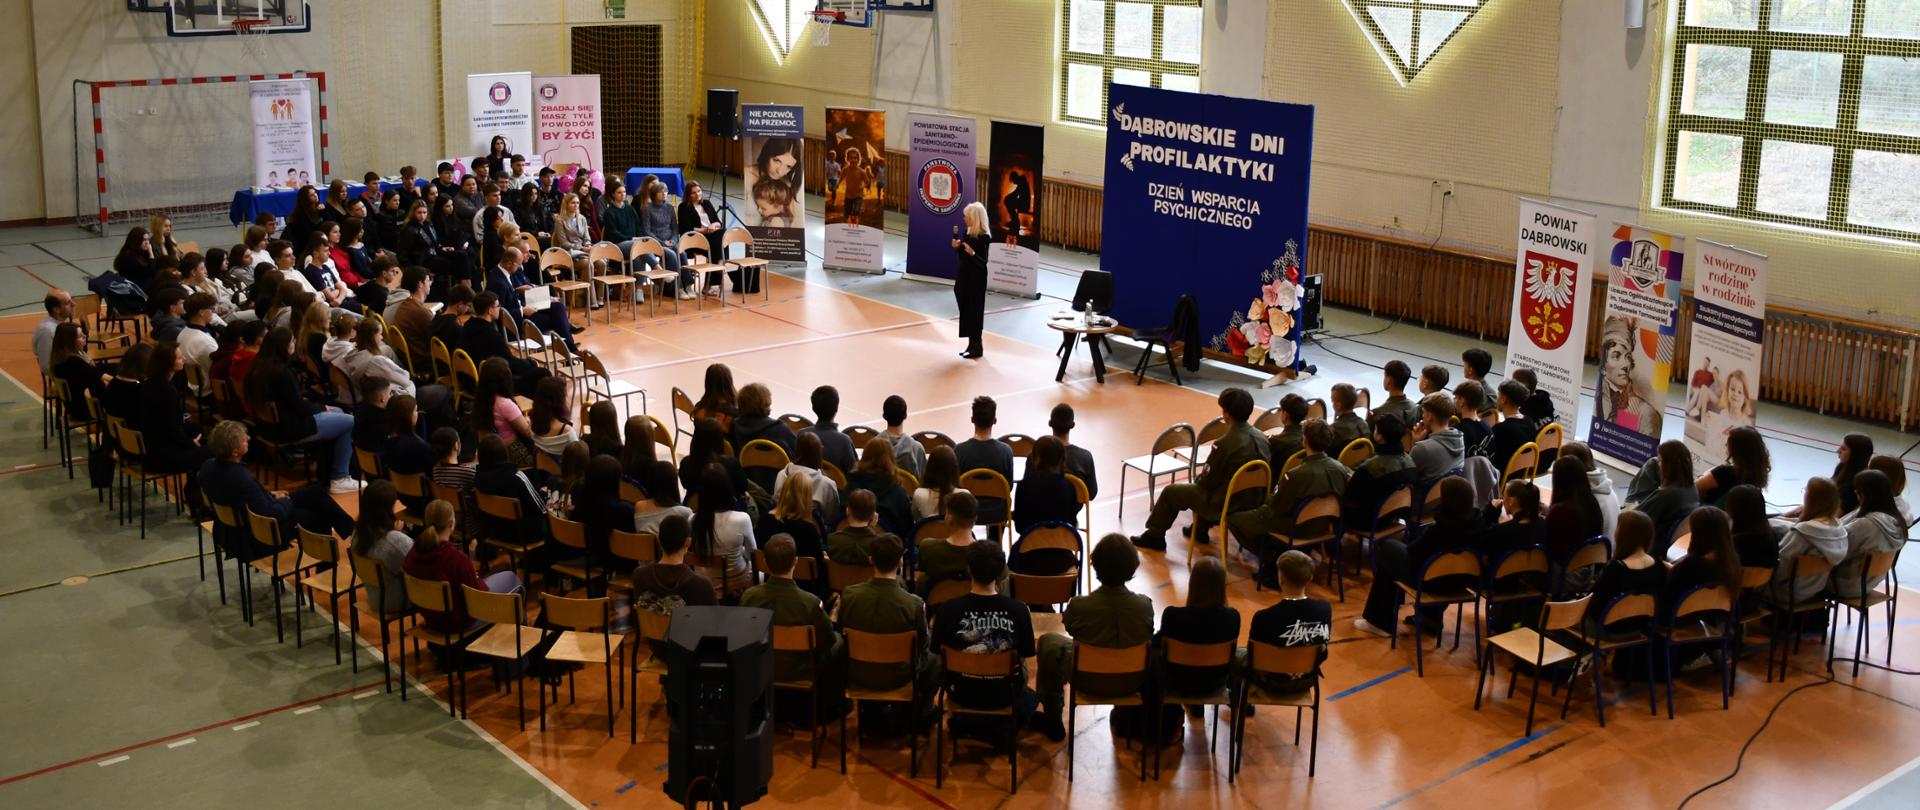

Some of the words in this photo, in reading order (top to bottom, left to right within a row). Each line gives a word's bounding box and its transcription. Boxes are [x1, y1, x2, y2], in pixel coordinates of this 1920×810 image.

[541, 119, 594, 127] POWODÓW
[749, 110, 761, 118] NIE
[762, 110, 795, 119] POZWÓL
[761, 119, 797, 127] PRZEMOC
[542, 131, 560, 140] BY
[564, 129, 595, 140] ŻYĆ!
[913, 121, 948, 131] POWIATOWA
[949, 125, 970, 133] STACJA
[1120, 114, 1237, 148] DĄBROWSKIE
[1250, 132, 1285, 155] DNI
[913, 137, 969, 149] EPIDEMIOLOGICZNA
[1130, 141, 1274, 182] PROFILAKTYKI
[1148, 182, 1184, 201] DZIEŃ
[1191, 189, 1260, 215] WSPARCIA
[1154, 200, 1253, 230] PSYCHICZNEGO
[1534, 212, 1578, 233] POWIAT
[1521, 228, 1587, 255] DĄBROWSKI
[1703, 254, 1757, 281] Stwórzmy
[1708, 271, 1749, 294] rodzinę
[1702, 284, 1710, 294] w
[1712, 287, 1756, 309] rodzinie
[1514, 353, 1541, 367] STAROSTWO
[1542, 362, 1570, 376] POWIATOWE
